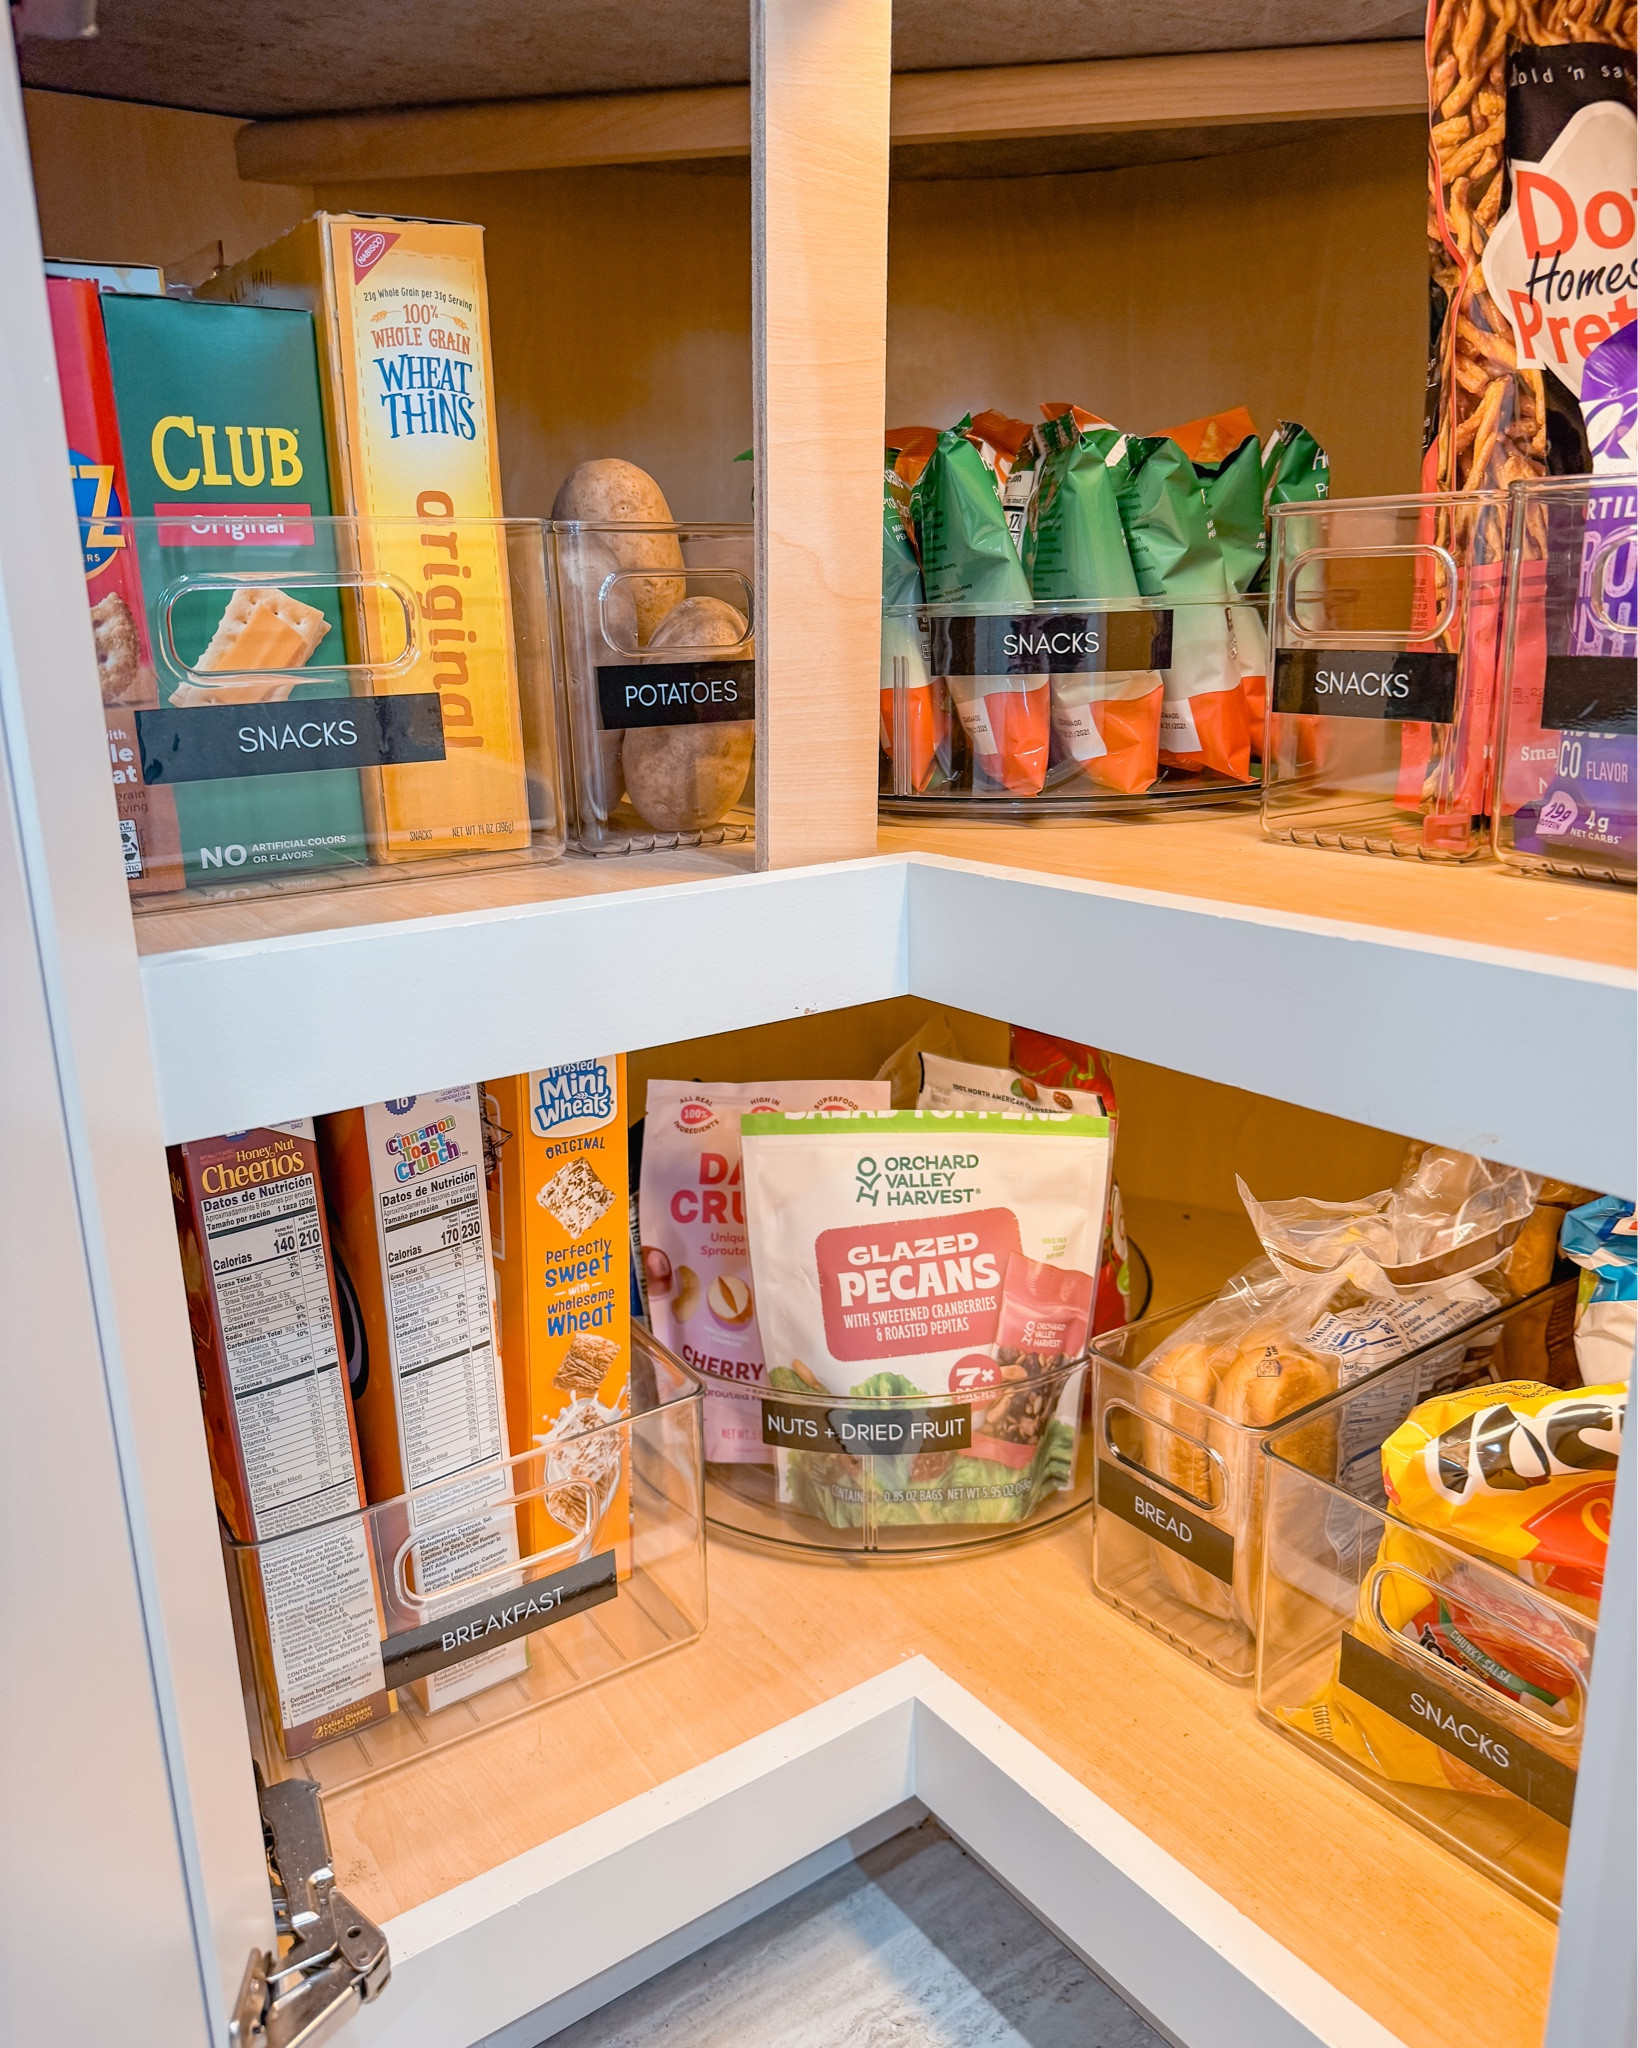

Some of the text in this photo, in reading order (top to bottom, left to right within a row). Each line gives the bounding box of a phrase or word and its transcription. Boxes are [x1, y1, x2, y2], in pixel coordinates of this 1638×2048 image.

[358, 236, 382, 264] NABISCO
[364, 287, 473, 312] 21g Whole Grain per 31g Serving
[402, 304, 439, 325] 100%
[371, 327, 471, 355] WHOLE GRAIN
[373, 354, 473, 395] WHEAT
[151, 415, 304, 491] CLUB
[191, 513, 285, 541] Original
[416, 490, 484, 748] original
[1003, 631, 1100, 656] SNACKS
[625, 680, 738, 708] POTATOES
[1314, 670, 1410, 698] SNACKS
[238, 719, 359, 754] SNACKS
[1586, 761, 1629, 784] FLAVOR
[1545, 801, 1573, 823] 19g
[1585, 809, 1610, 833] 4g
[409, 829, 433, 842] SNACKS
[452, 820, 515, 838] NET WT 14 OZ (396g)
[1570, 827, 1588, 838] NET
[252, 835, 347, 852] ARTIFICIAL COLORS
[200, 844, 248, 870] NO
[253, 850, 315, 864] OR FLAVORS
[542, 1067, 606, 1106] Mini
[952, 1083, 1025, 1108] 100% NORTH AMERICAN
[537, 1094, 609, 1129] Wheats
[679, 1096, 713, 1107] ALL REAL
[684, 1108, 708, 1120] 100%
[750, 1096, 780, 1107] HIGH IN
[813, 1095, 859, 1112] SUPERFOOD
[387, 1115, 456, 1154] Cinnamon
[673, 1119, 720, 1135] INGREDIENTS
[236, 1138, 295, 1162] Honey Nut
[402, 1132, 446, 1163] Toast
[545, 1136, 606, 1159] ORIGINAL
[201, 1151, 305, 1195] Cheerios
[395, 1141, 461, 1182] Crunch
[884, 1154, 979, 1170] ORCHARD
[382, 1171, 476, 1208] Datos de Nutrición
[884, 1172, 956, 1188] VALLEY
[203, 1175, 313, 1213] Datos de Nutrición
[285, 1195, 294, 1204] por
[887, 1188, 974, 1206] HARVEST
[206, 1196, 315, 1231] Tamaño por ración taza (37g)
[384, 1190, 478, 1226] Tamaño ración taza (41g)
[274, 1228, 320, 1254] 140 210
[440, 1223, 480, 1246] 170 230
[388, 1245, 422, 1262] Calorías
[847, 1231, 979, 1266] GLAZED
[213, 1253, 253, 1271] Calorías
[545, 1252, 613, 1288] sweet
[217, 1275, 252, 1290] Grasa Total
[568, 1282, 590, 1296] with
[837, 1253, 1001, 1307] PECANS
[547, 1288, 615, 1315] wholesome
[843, 1295, 998, 1329] WITH SWEETENED CRANBERRIES
[223, 1320, 256, 1333] Colesterol
[225, 1333, 243, 1342] Sodio
[876, 1316, 970, 1341] & ROASTED PEPITAS
[1037, 1322, 1066, 1331] ORCHARD
[227, 1330, 283, 1350] Carbohidrato Total
[1033, 1339, 1061, 1348] HARVEST
[682, 1344, 764, 1380] CHERRY
[234, 1381, 263, 1393] Proteínas
[721, 1429, 736, 1439] NET
[768, 1413, 966, 1442] NUTS + DRIED FRUIT
[884, 1491, 904, 1502] 0.85
[905, 1491, 918, 1502] OZ
[919, 1490, 943, 1501] BAGS
[947, 1489, 965, 1500] NET
[966, 1488, 981, 1499] WT
[982, 1486, 1000, 1498] 5.95
[1003, 1485, 1014, 1496] OZ
[1134, 1495, 1193, 1543] BREAD
[441, 1585, 565, 1653] BREAKFAST
[287, 1664, 317, 1679] CONTIENE
[317, 1643, 361, 1667] INGREDIENTES
[1450, 1630, 1485, 1663] CHUNKY
[1482, 1659, 1512, 1684] SALSA
[323, 1705, 372, 1730] Celiac Disease
[324, 1712, 374, 1737] FOUNDATION
[1410, 1692, 1510, 1769] SNACKS
